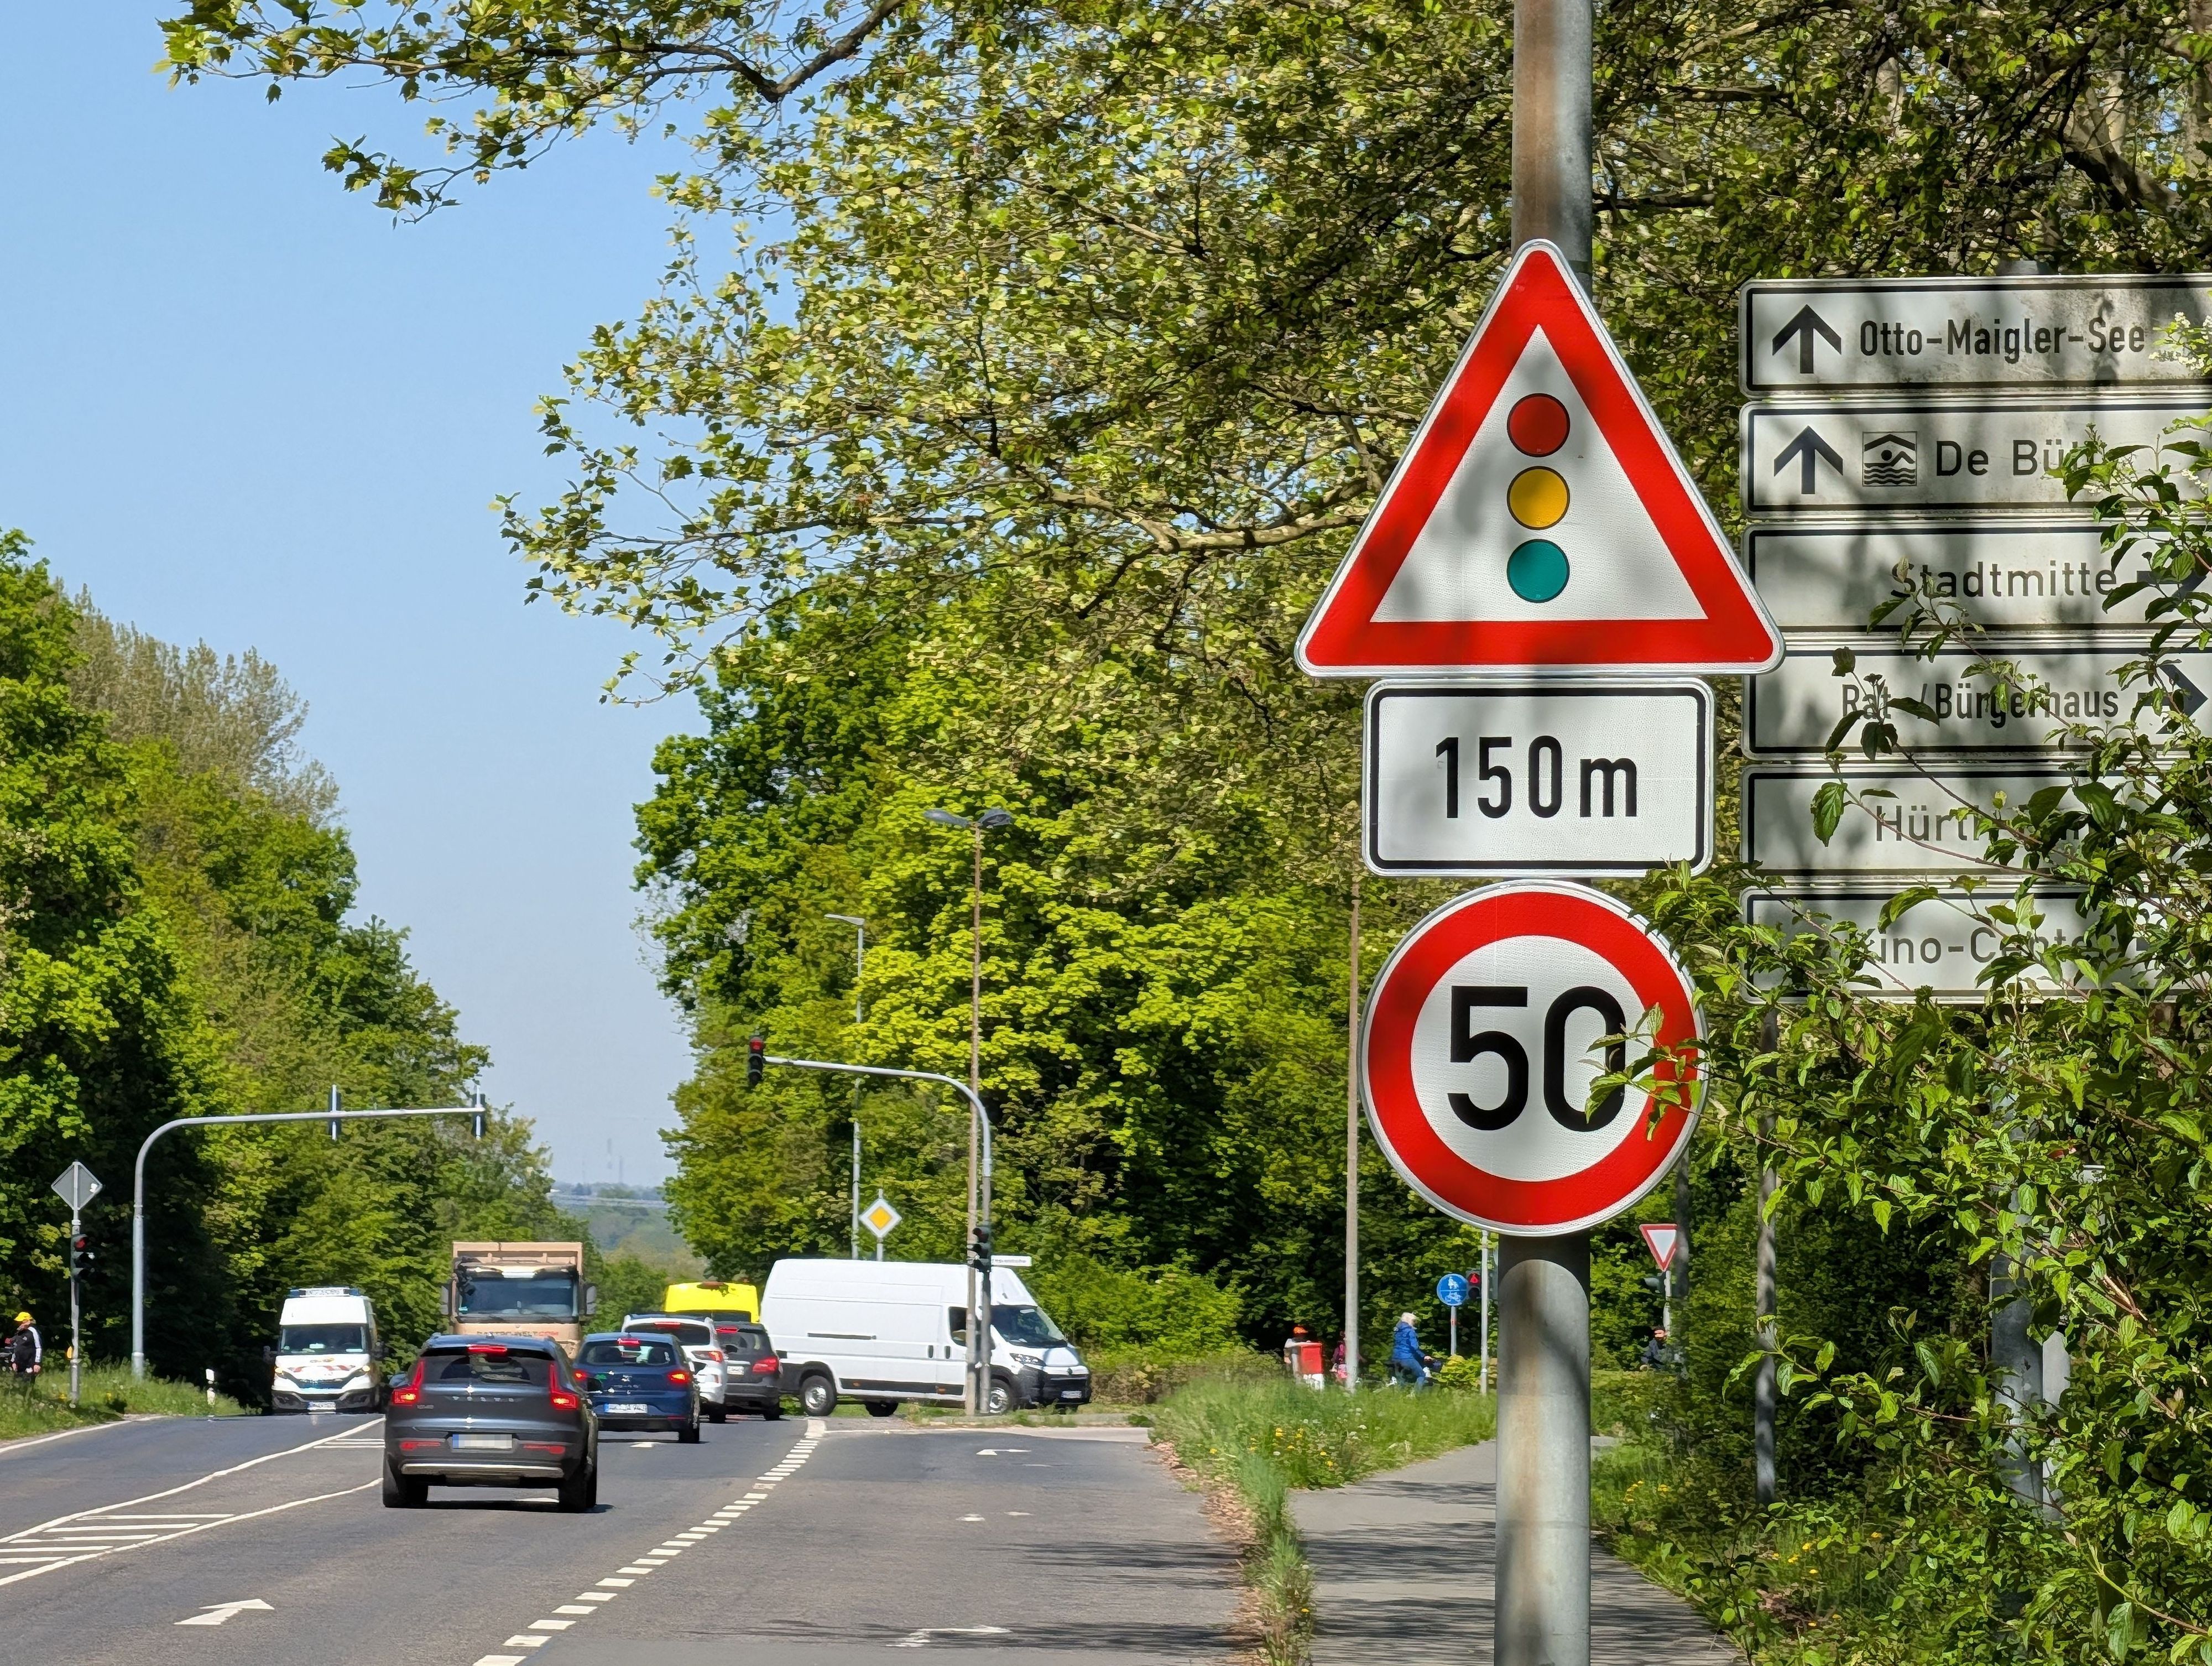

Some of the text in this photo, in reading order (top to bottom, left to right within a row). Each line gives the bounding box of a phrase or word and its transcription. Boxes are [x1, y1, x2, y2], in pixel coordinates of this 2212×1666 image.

[1860, 317, 2145, 364] Otto-Maigler-See
[1936, 440, 1989, 477] De
[1891, 560, 2117, 597] Stadtmitte
[1447, 986, 1626, 1132] 50
